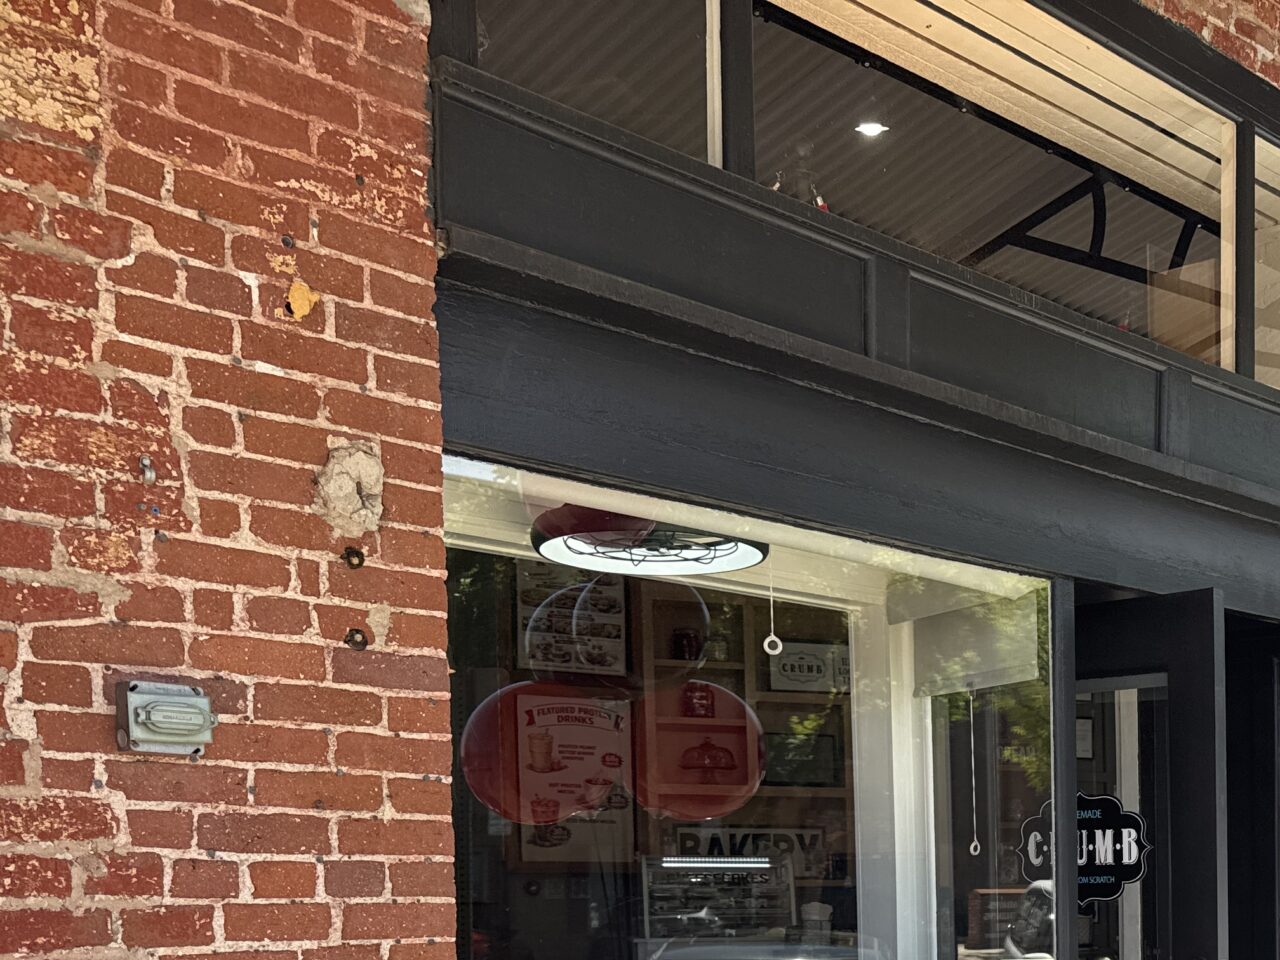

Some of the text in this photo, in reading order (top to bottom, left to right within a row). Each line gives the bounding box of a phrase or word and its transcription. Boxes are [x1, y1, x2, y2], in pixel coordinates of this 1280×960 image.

[537, 706, 576, 717] FEATURED
[557, 715, 594, 725] DRINKS
[1076, 809, 1102, 819] EMADE
[680, 832, 820, 872] BAKERY
[1077, 875, 1115, 884] OM SCRATCH
